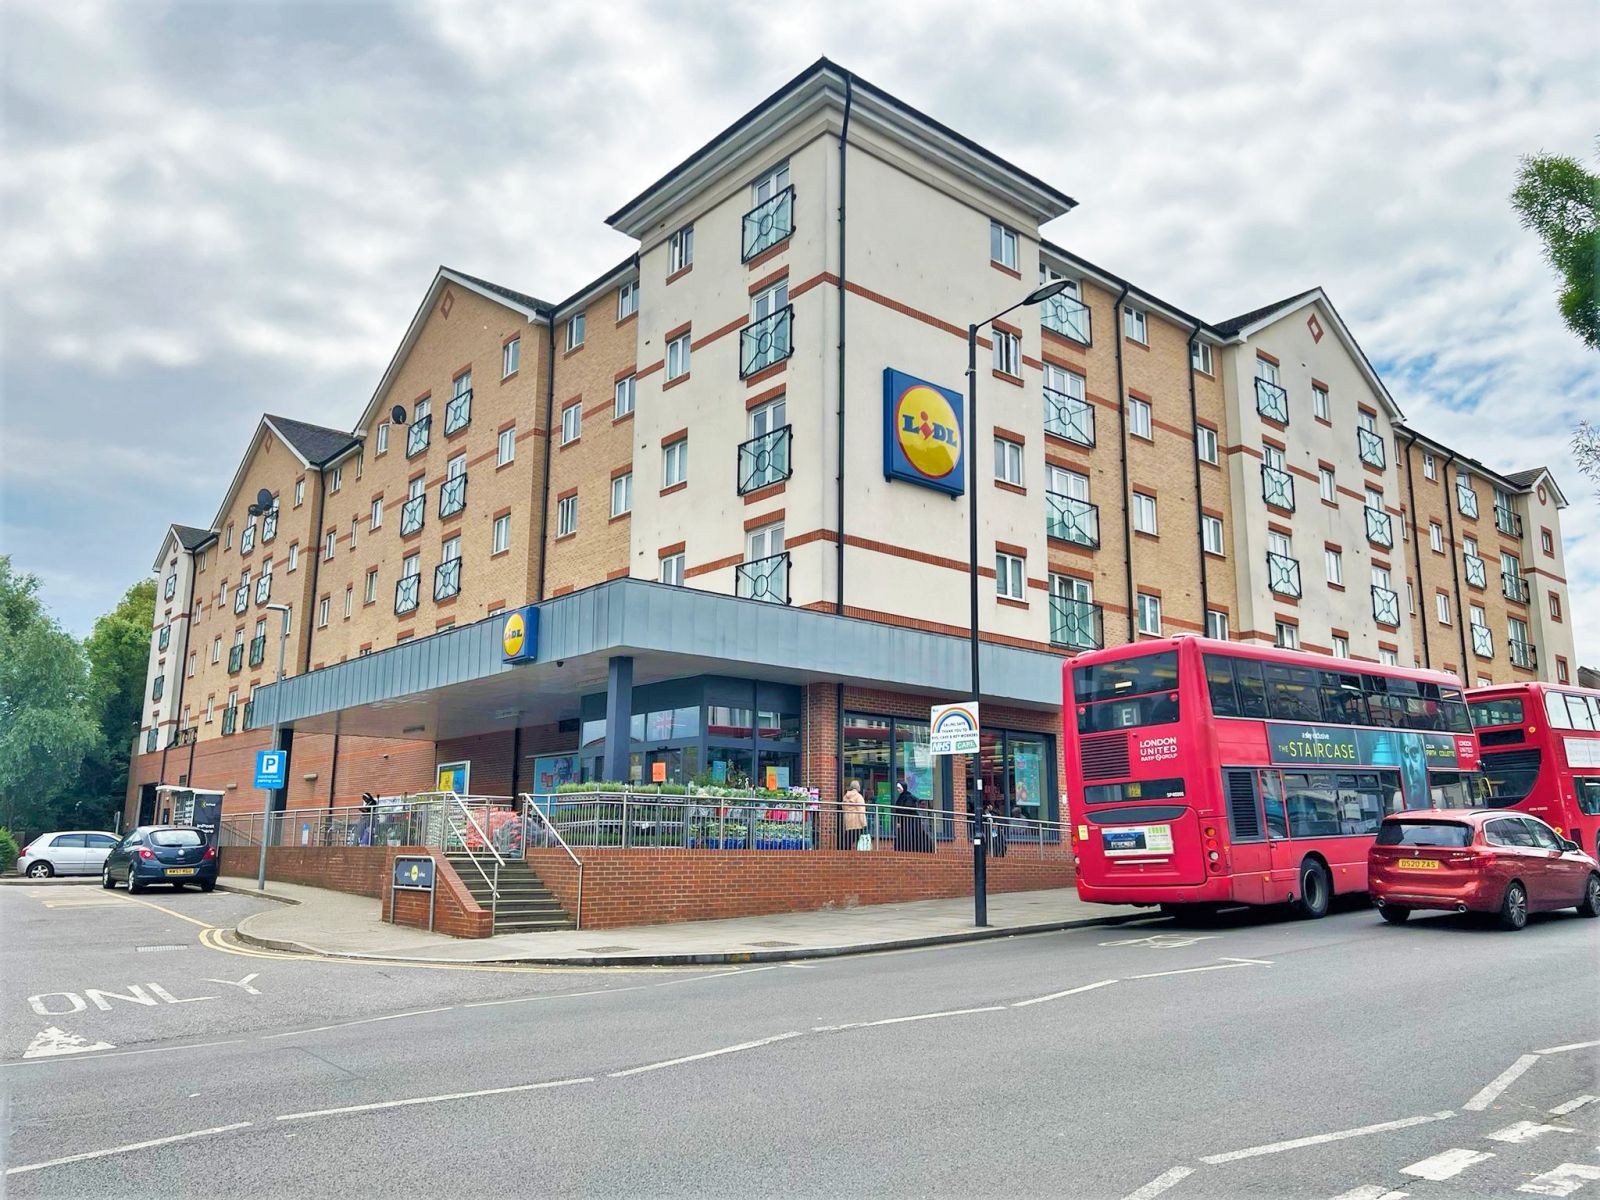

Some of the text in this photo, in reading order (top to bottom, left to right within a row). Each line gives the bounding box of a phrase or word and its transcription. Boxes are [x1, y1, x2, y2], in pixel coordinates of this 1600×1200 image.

[932, 742, 950, 752] NHS
[1139, 737, 1178, 749] LONDON
[1140, 745, 1178, 757] UNITED
[1278, 741, 1356, 759] THE STAIRCASE
[265, 757, 276, 771] P
[27, 973, 263, 1016] ONLY
